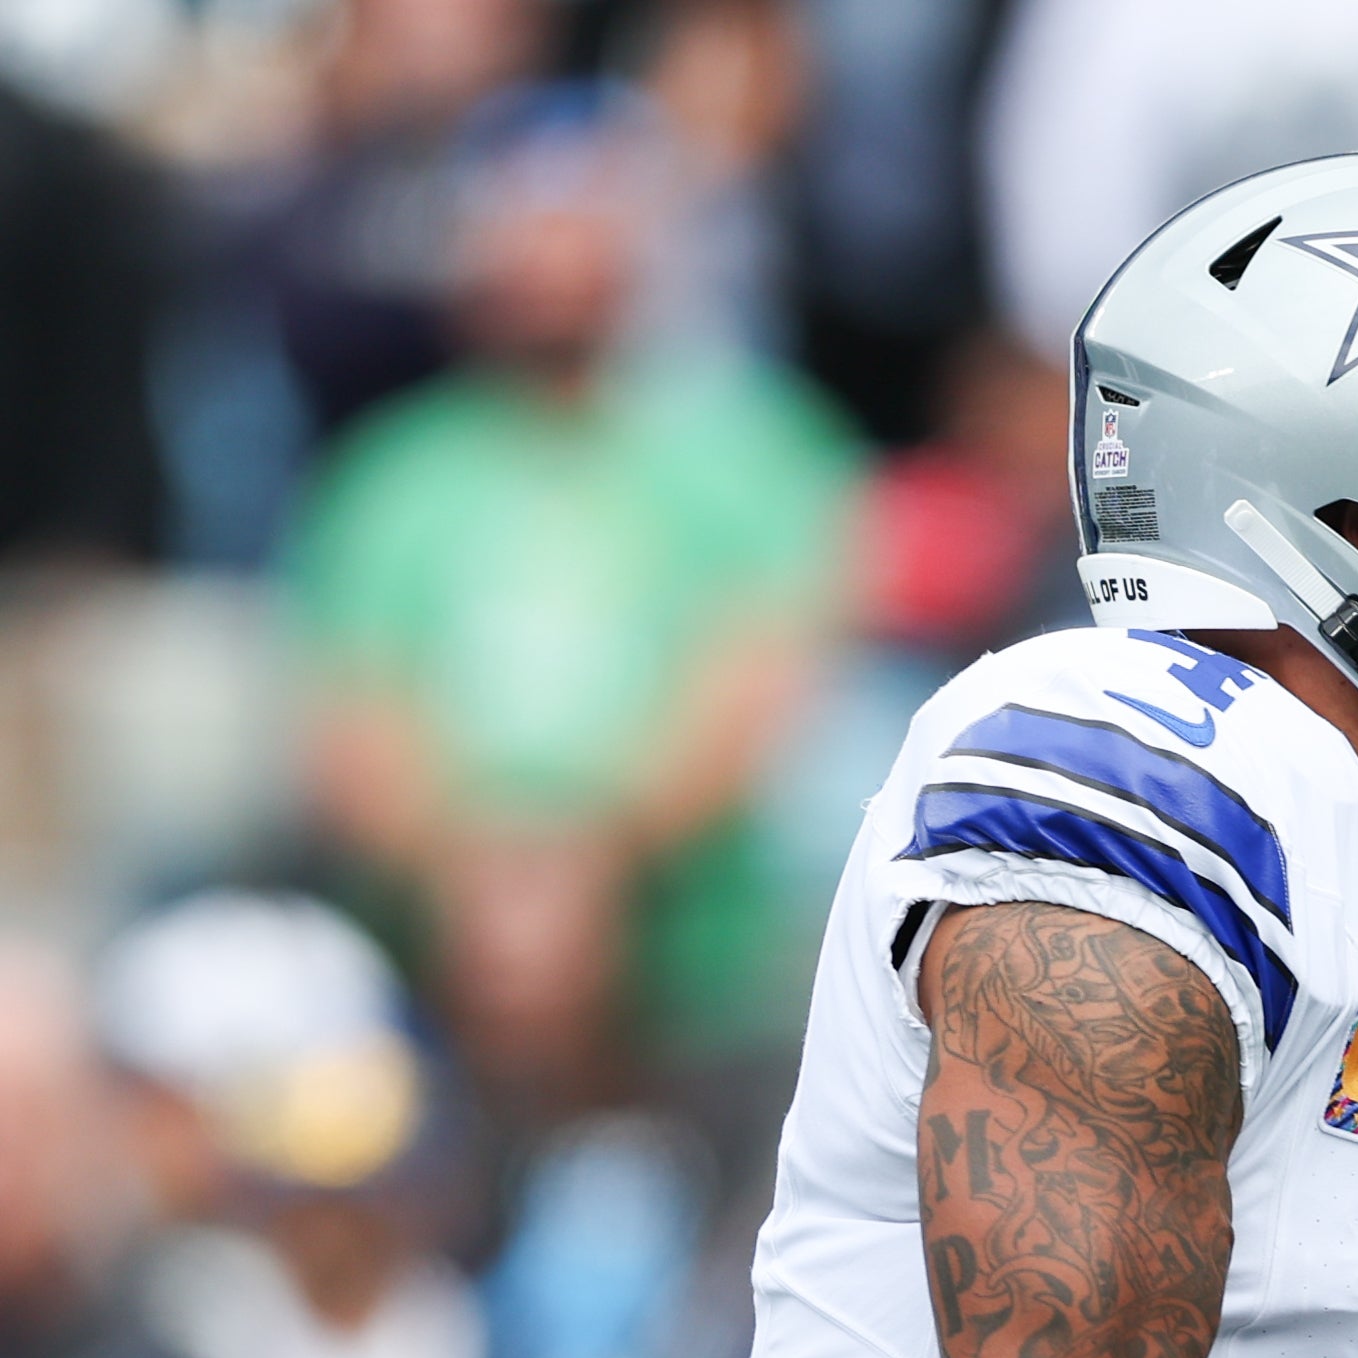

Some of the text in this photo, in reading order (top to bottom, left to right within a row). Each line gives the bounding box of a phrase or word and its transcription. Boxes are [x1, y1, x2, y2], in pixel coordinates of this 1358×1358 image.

[1094, 450, 1127, 468] CATCH
[1100, 579, 1119, 602] OF
[1122, 578, 1148, 601] US
